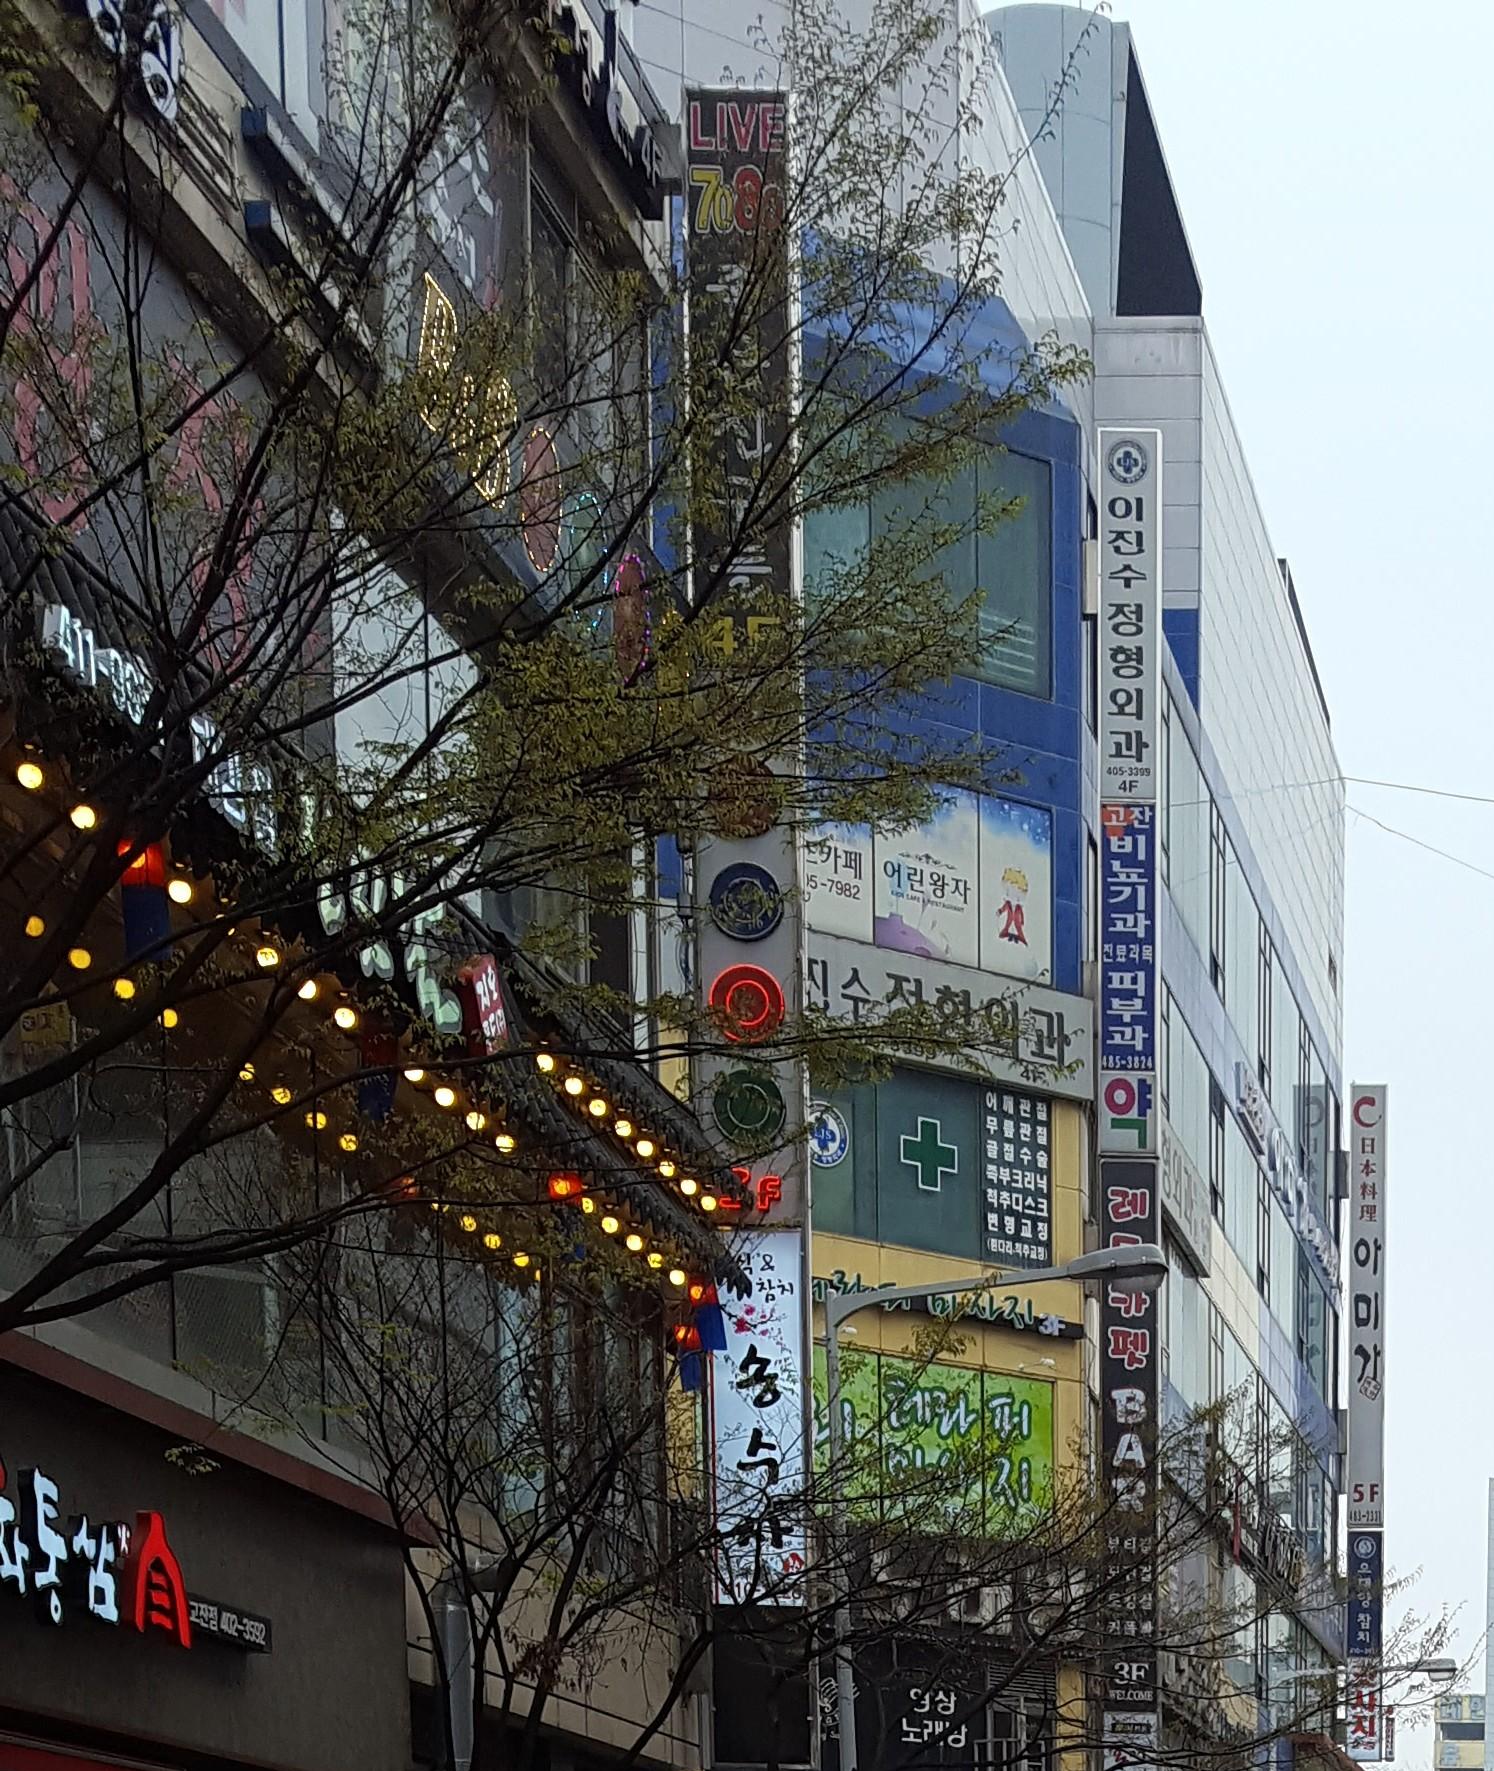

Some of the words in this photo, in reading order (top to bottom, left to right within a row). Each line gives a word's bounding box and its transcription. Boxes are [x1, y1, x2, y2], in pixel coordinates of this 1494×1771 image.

[689, 101, 786, 152] LIVE
[1106, 495, 1150, 764] 이진수정형외과
[1105, 805, 1151, 830] 고잔
[1118, 780, 1140, 794] 4F
[883, 859, 971, 905] 어린왕자
[1108, 836, 1151, 939] 비뇨기과
[1107, 972, 1149, 1052] 피부과
[1104, 1077, 1153, 1149] 약
[1353, 1236, 1381, 1385] 아미가
